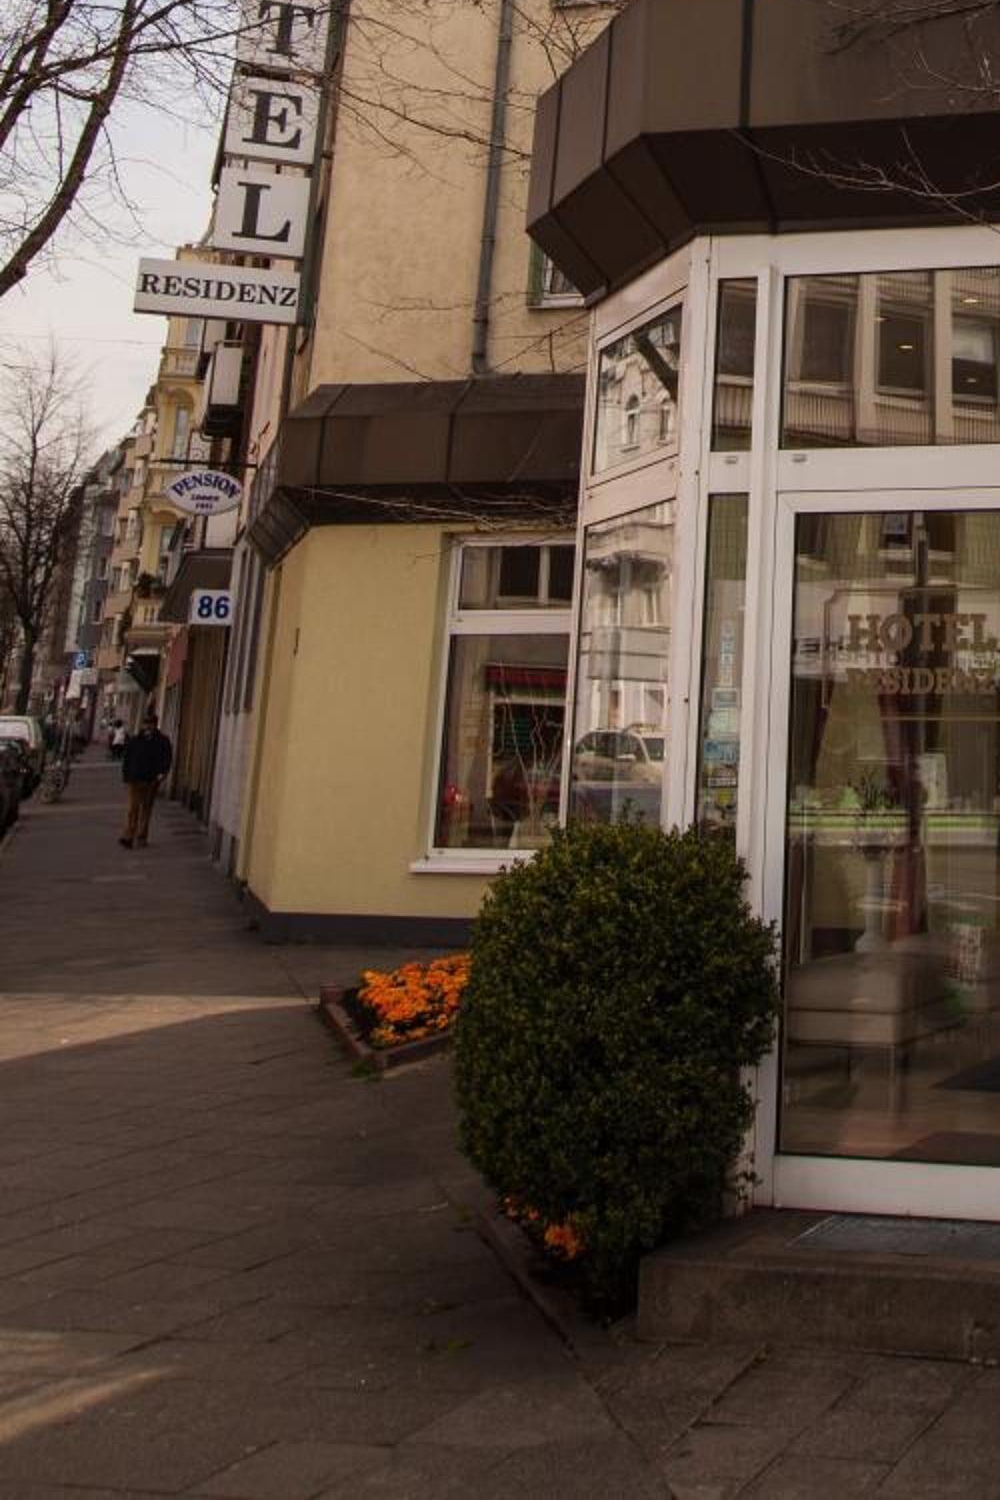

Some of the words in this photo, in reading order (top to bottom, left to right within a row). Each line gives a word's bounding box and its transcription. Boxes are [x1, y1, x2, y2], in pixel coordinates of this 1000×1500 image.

[140, 272, 298, 307] RESIDENZ
[172, 474, 241, 499] PENSION
[198, 596, 229, 619] 86
[847, 613, 997, 652] HOTEL
